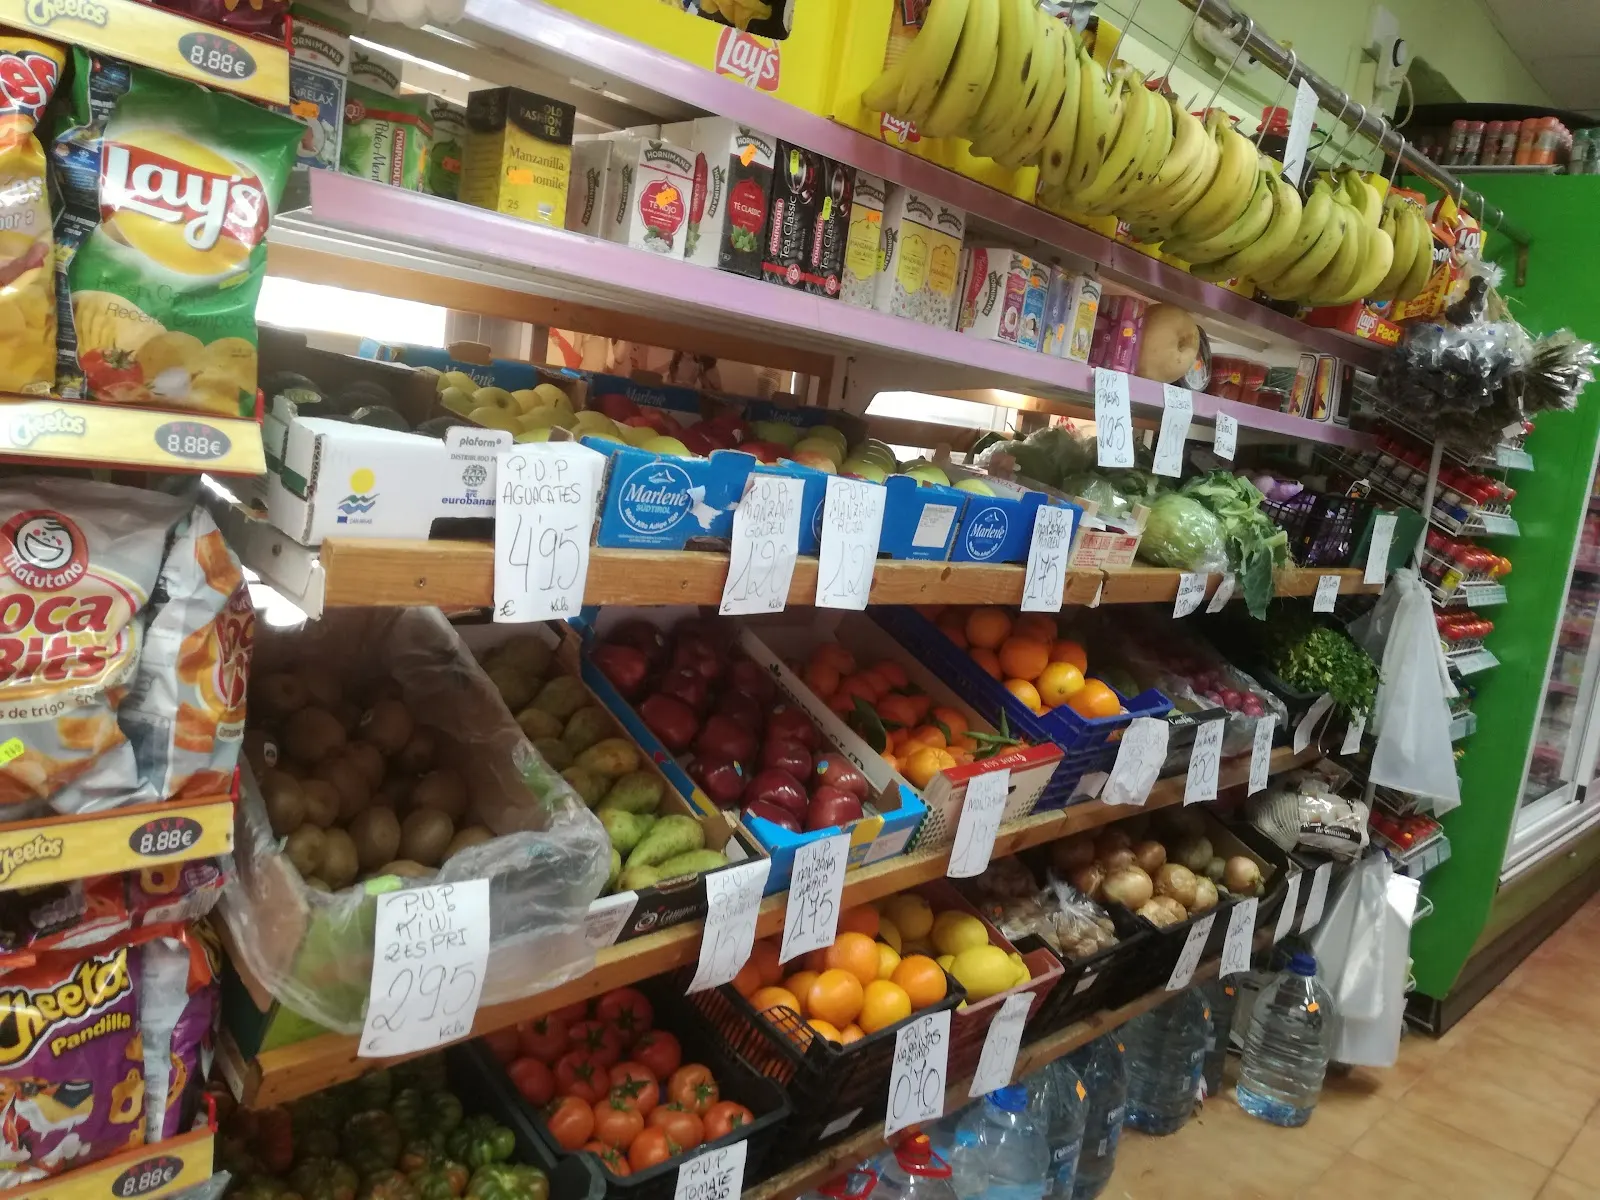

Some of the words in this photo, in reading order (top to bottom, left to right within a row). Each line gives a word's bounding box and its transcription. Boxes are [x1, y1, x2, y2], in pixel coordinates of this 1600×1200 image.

[190, 45, 246, 77] 8.88€
[292, 36, 340, 65] ORNIMANS
[719, 27, 779, 89] Lay's
[509, 145, 564, 171] Manzanilla
[646, 150, 690, 172] HORNIMANS
[102, 145, 262, 251] Lay's
[709, 168, 721, 217] HORNIMANS
[741, 206, 761, 217] CLASSIC
[784, 195, 797, 235] Classic
[772, 200, 784, 253] POMPADOUR
[780, 238, 791, 258] Tea
[820, 249, 830, 269] Tea
[983, 271, 997, 316] HORNIMANS
[1375, 323, 1400, 342] Pack
[167, 434, 221, 456] 8.88€
[503, 482, 581, 506] AGUACATES
[625, 483, 689, 507] Marlene
[745, 523, 785, 538] GOLDEN
[3, 552, 84, 588] matutano
[8, 708, 28, 719] de
[32, 701, 65, 717] trigo
[140, 829, 193, 854] 8.88€
[0, 834, 63, 880] heetos
[51, 1012, 131, 1057] Pandilla
[122, 1170, 174, 1197] 8.88€
